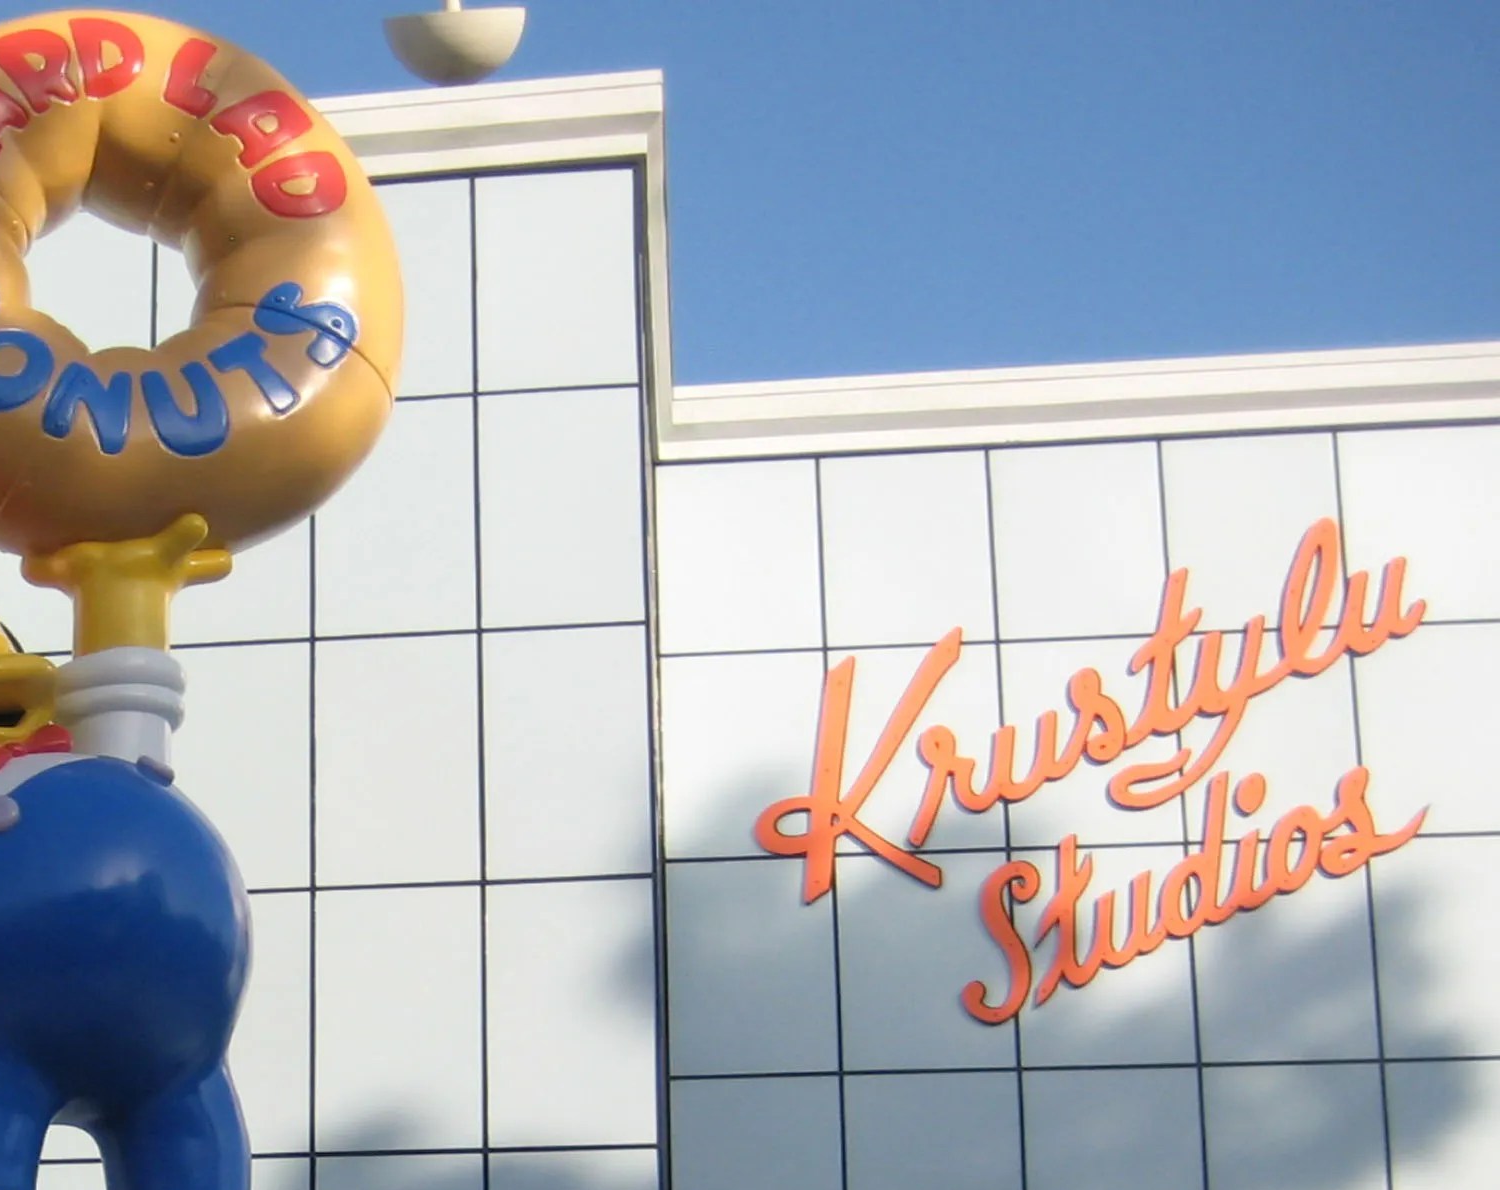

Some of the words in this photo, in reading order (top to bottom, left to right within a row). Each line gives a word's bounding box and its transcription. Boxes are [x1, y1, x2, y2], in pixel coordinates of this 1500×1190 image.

[164, 38, 347, 219] LAD
[754, 517, 1426, 905] Krustylu
[961, 766, 1430, 1025] Studios
